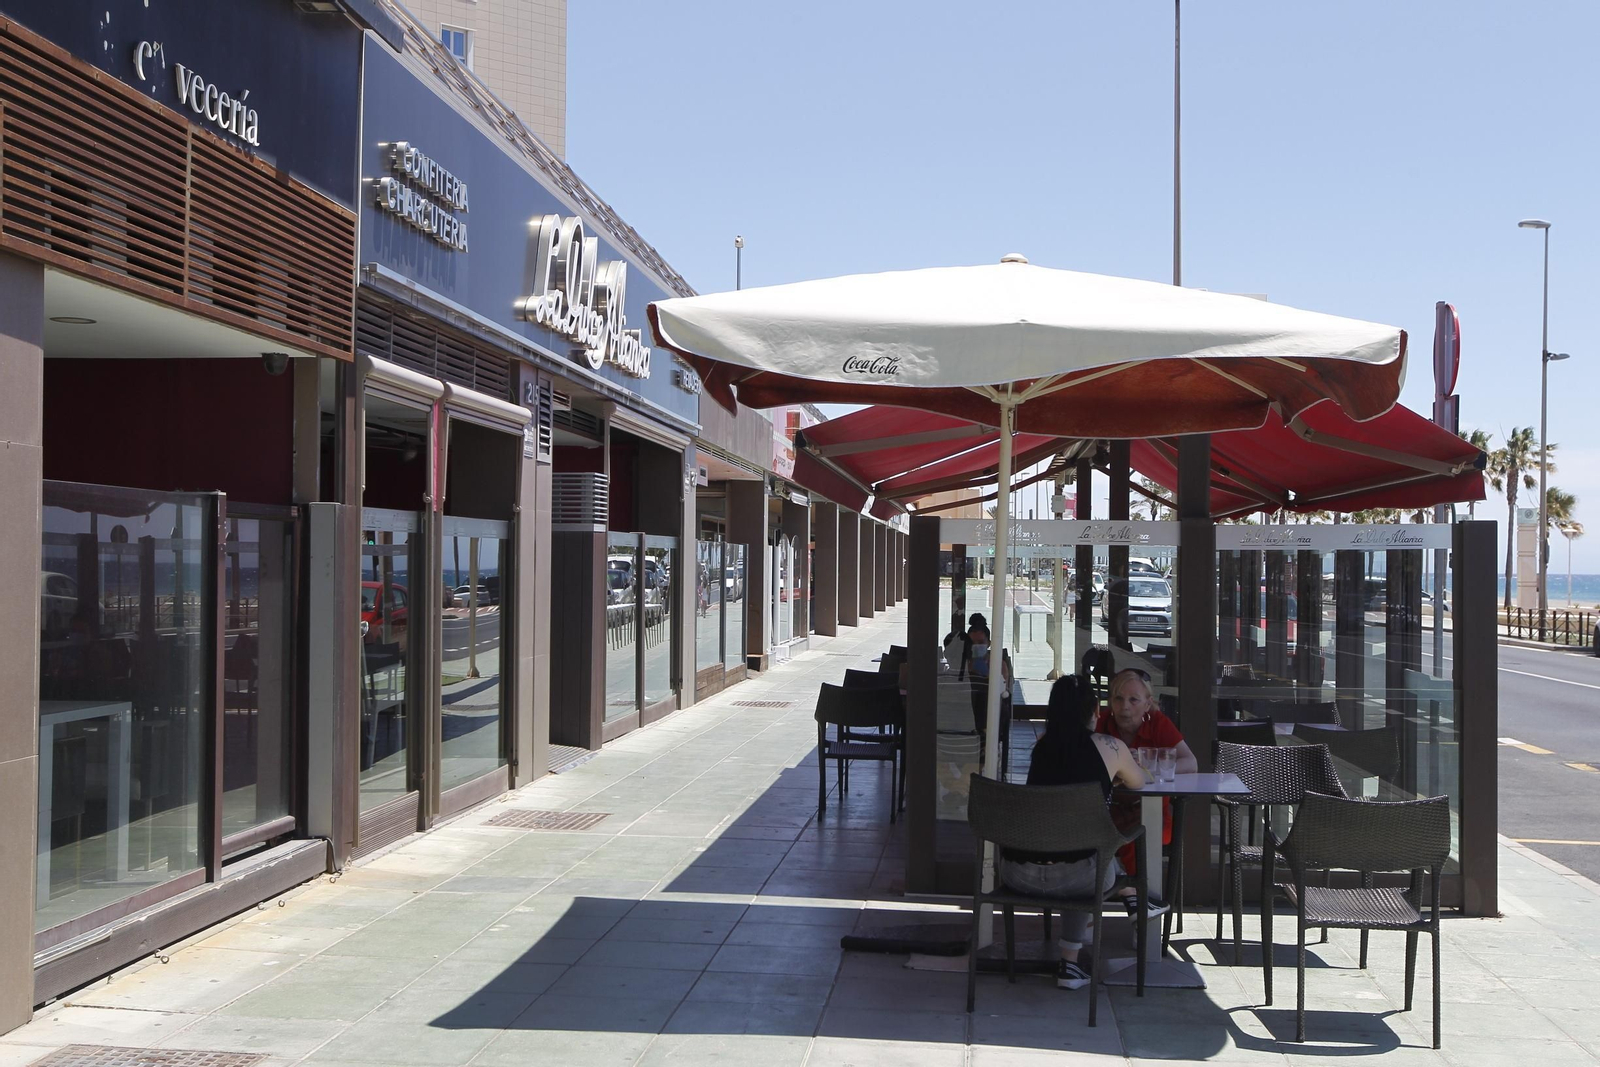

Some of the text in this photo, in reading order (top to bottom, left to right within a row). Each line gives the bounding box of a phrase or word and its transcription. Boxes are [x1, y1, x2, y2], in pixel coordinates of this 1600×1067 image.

[377, 176, 469, 253] CHARCUTERIA
[842, 355, 901, 375] Coca-Cola
[1077, 525, 1092, 539] La
[1350, 530, 1364, 544] La
[1386, 529, 1424, 544] Alianza
